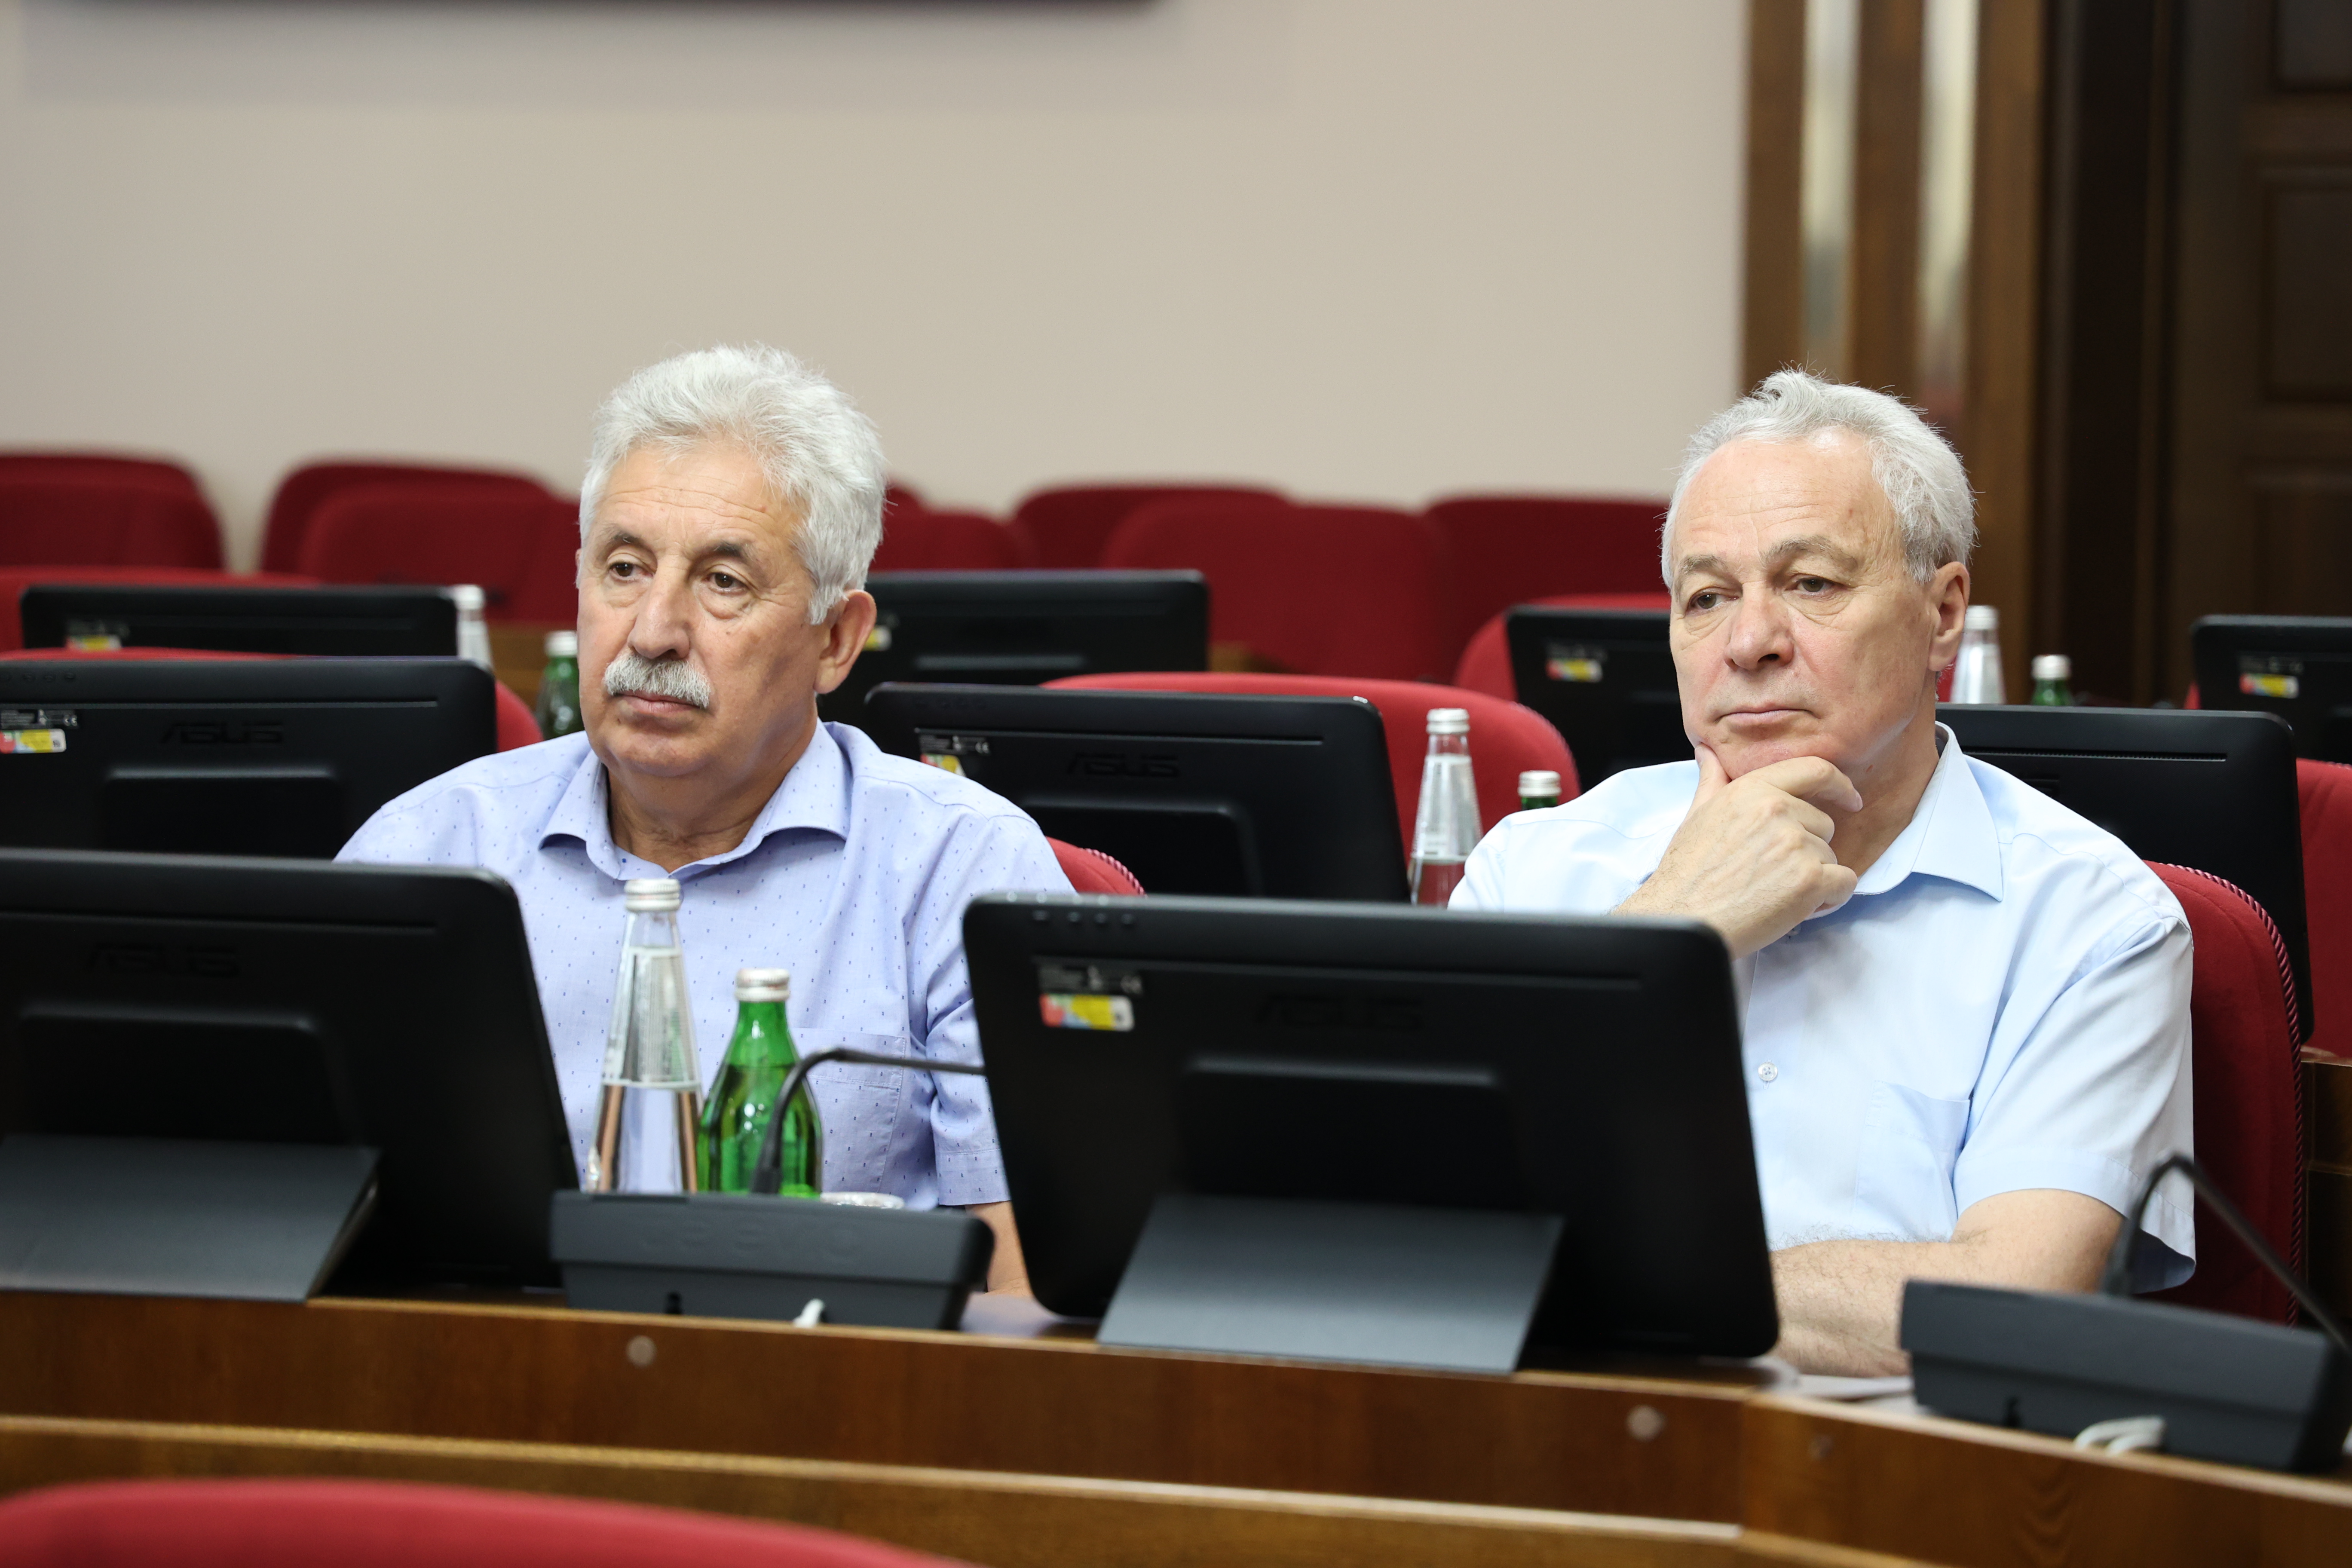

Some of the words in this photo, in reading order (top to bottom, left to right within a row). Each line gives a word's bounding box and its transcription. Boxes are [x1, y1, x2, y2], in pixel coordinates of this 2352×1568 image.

[159, 721, 283, 743] ASUS
[1066, 753, 1179, 777] ASUS
[83, 942, 239, 978] ASUS
[1253, 993, 1425, 1030] ASUS
